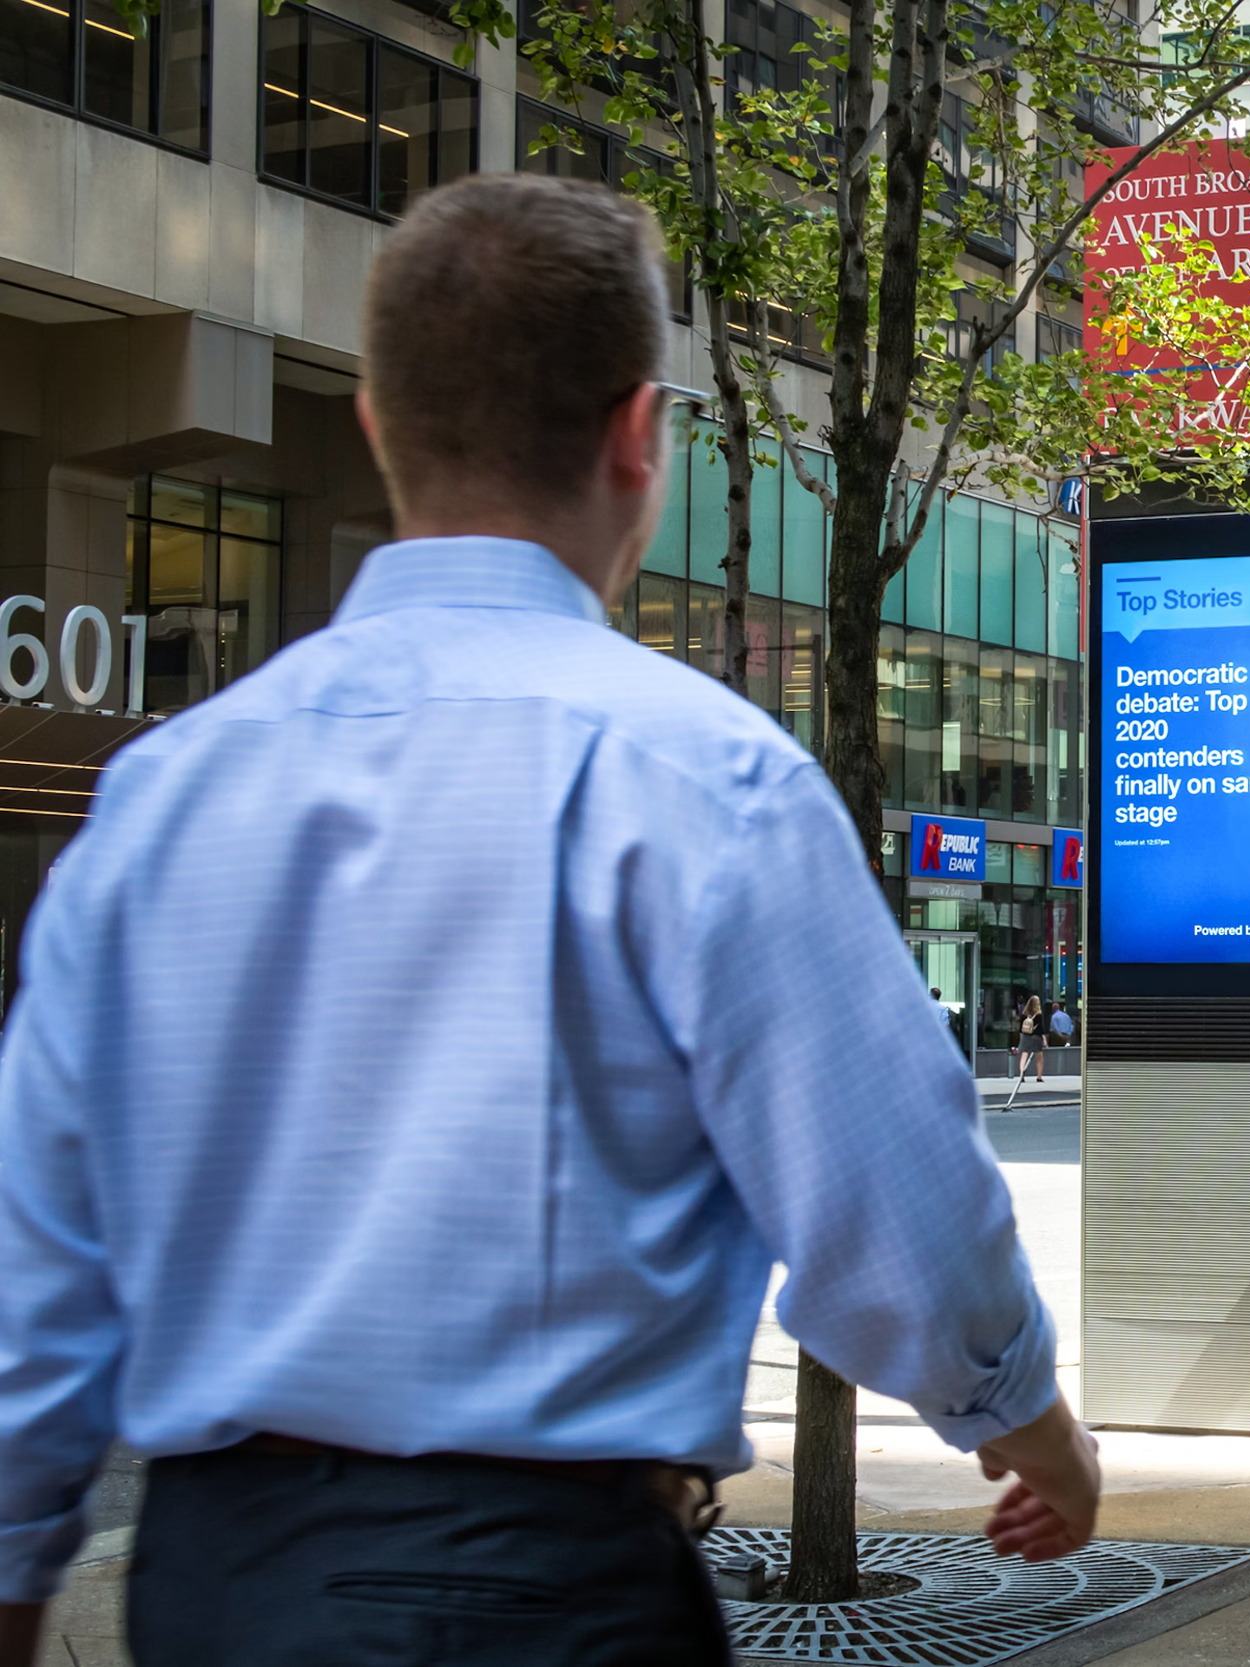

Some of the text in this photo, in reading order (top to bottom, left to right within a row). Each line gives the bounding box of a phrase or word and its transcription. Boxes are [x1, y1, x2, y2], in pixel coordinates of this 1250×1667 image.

[1102, 175, 1186, 203] SOUTH
[1116, 588, 1243, 615] Top Stories
[0, 594, 147, 712] 601
[1116, 662, 1248, 687] Democratic
[1116, 690, 1248, 715] debate: Top
[1115, 719, 1168, 741] 2020
[1116, 745, 1244, 768] contenders
[1115, 773, 1181, 799] finally
[1187, 776, 1216, 794] on
[1115, 803, 1178, 827] stage
[921, 823, 980, 870] REPUBLIC
[948, 857, 976, 873] BANK
[945, 885, 951, 896] 7
[1194, 925, 1243, 936] Powered
